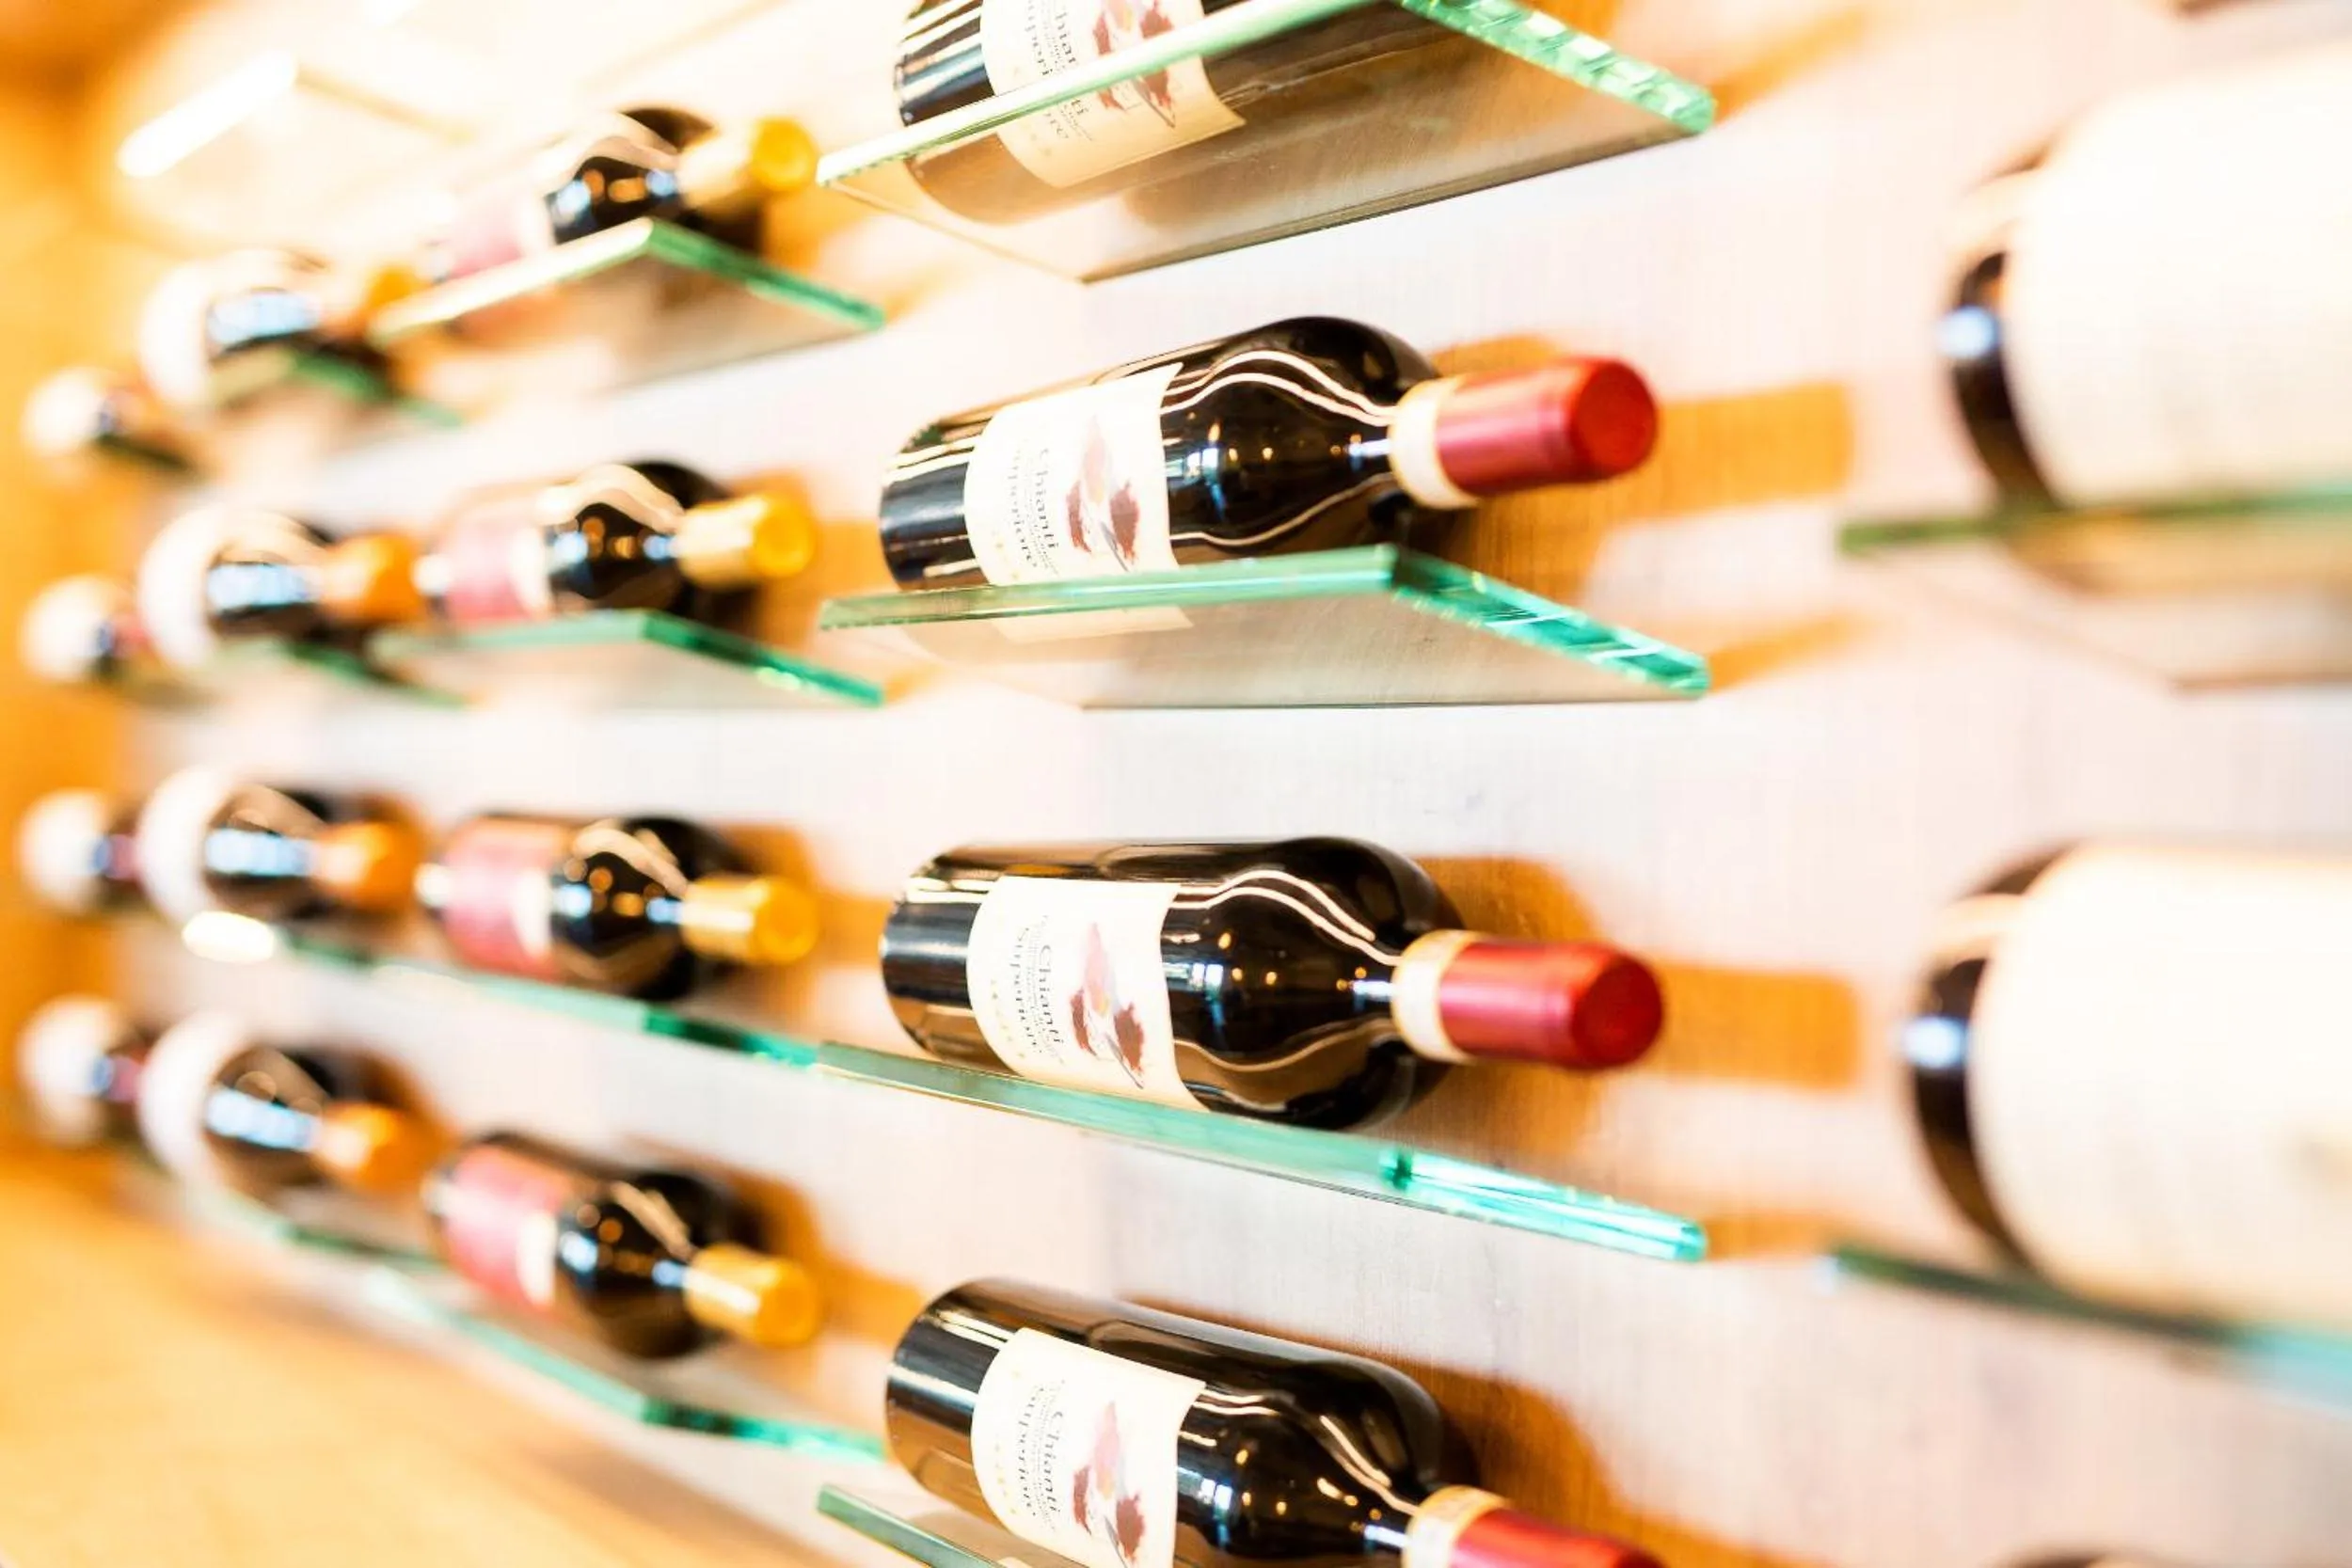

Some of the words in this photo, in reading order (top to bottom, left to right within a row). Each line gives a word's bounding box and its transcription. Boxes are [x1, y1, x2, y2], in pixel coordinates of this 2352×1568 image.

[1036, 448, 1059, 549] Chianti
[1009, 927, 1042, 1053] Superiore
[1040, 944, 1064, 1043] Chianti
[1043, 1411, 1063, 1513] Chianti
